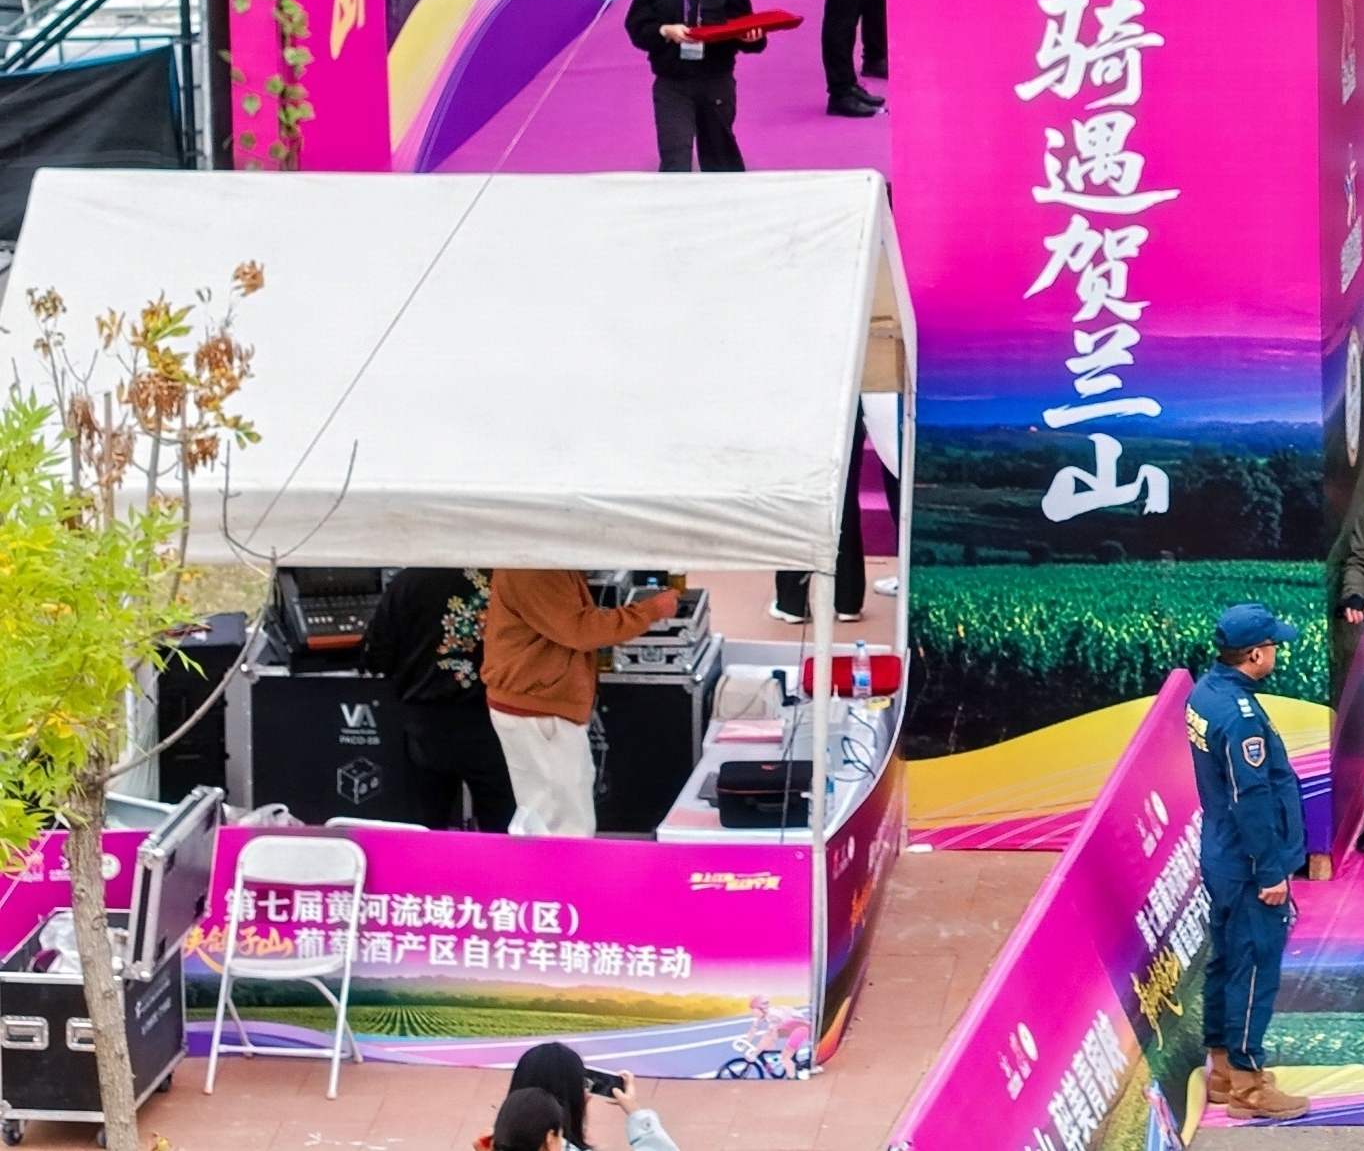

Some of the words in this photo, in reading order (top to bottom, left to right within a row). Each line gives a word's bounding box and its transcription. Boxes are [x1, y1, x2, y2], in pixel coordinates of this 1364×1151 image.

[223, 887, 580, 937] 第七届黄河流域九省(区)
